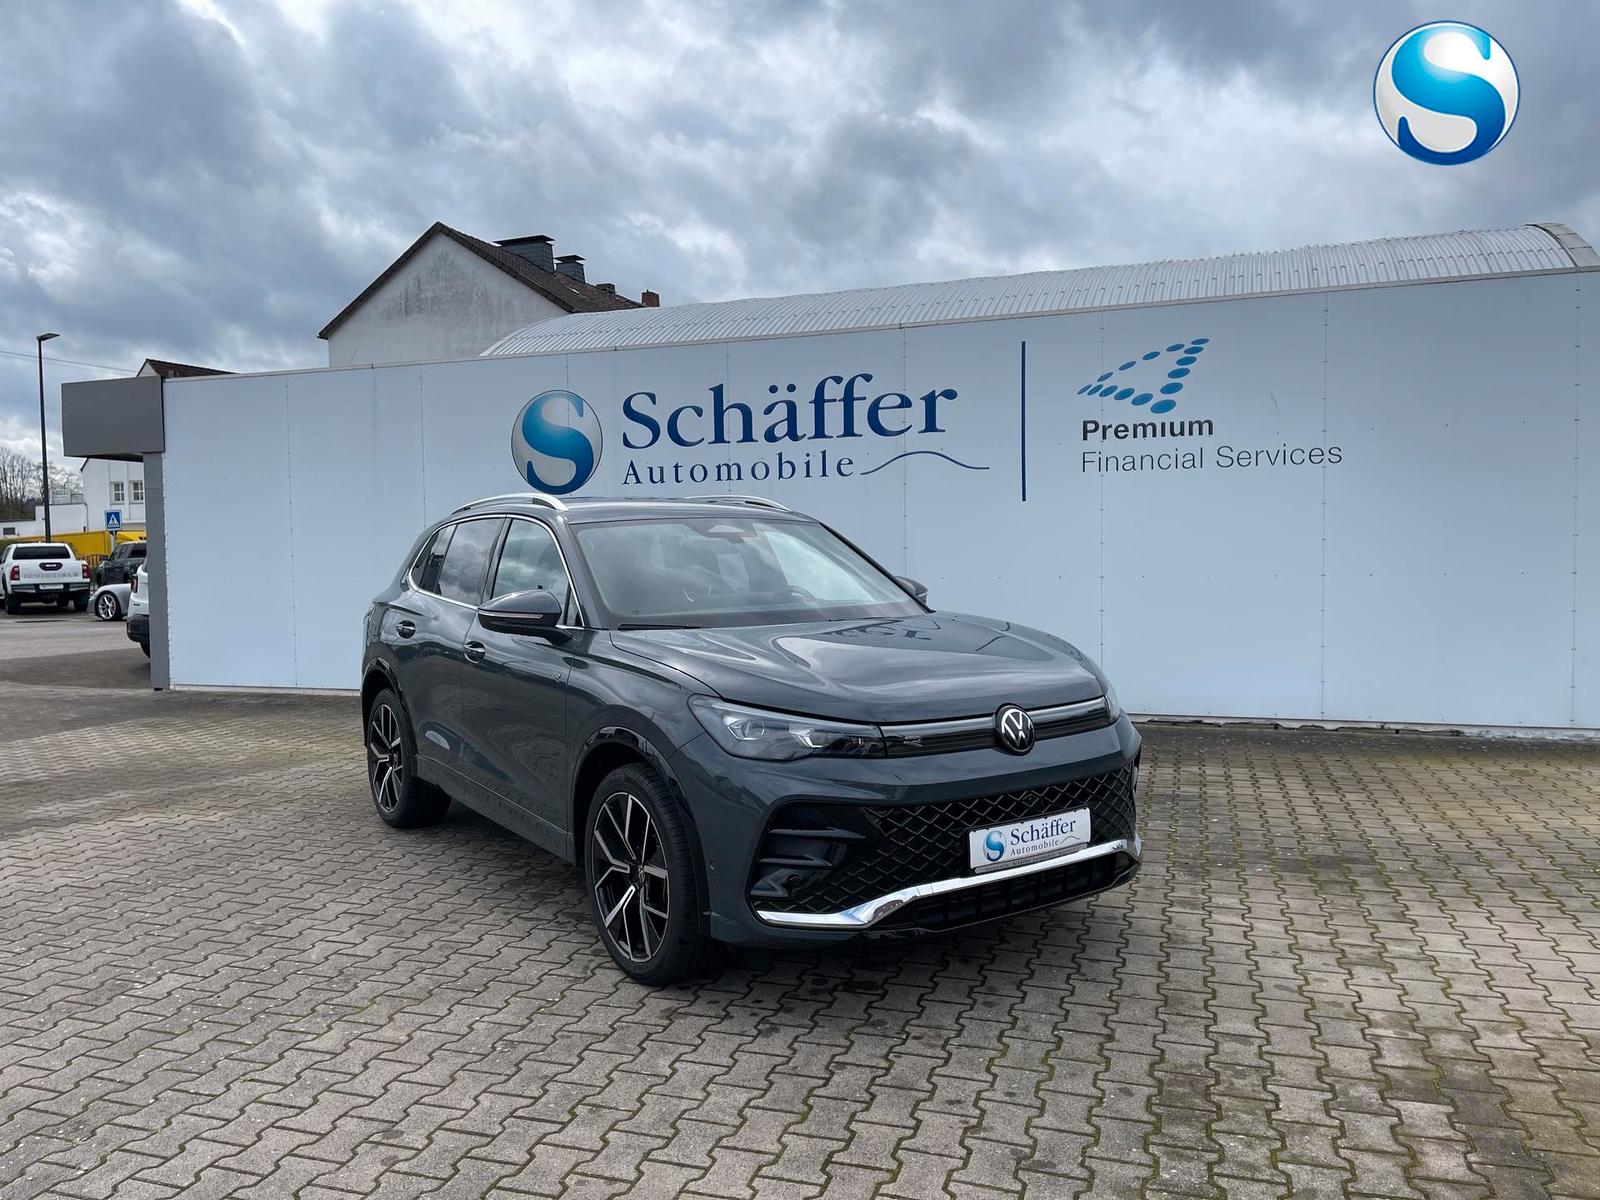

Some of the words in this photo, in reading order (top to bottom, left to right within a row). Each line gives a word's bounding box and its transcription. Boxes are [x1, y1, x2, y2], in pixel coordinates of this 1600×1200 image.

[622, 373, 958, 450] Schäffer
[1082, 418, 1214, 441] Premium
[622, 451, 854, 485] Automobile
[1082, 447, 1203, 473] Financial
[1216, 443, 1342, 468] Services
[1010, 818, 1076, 846] Schäffer
[1010, 839, 1059, 856] Automobile
